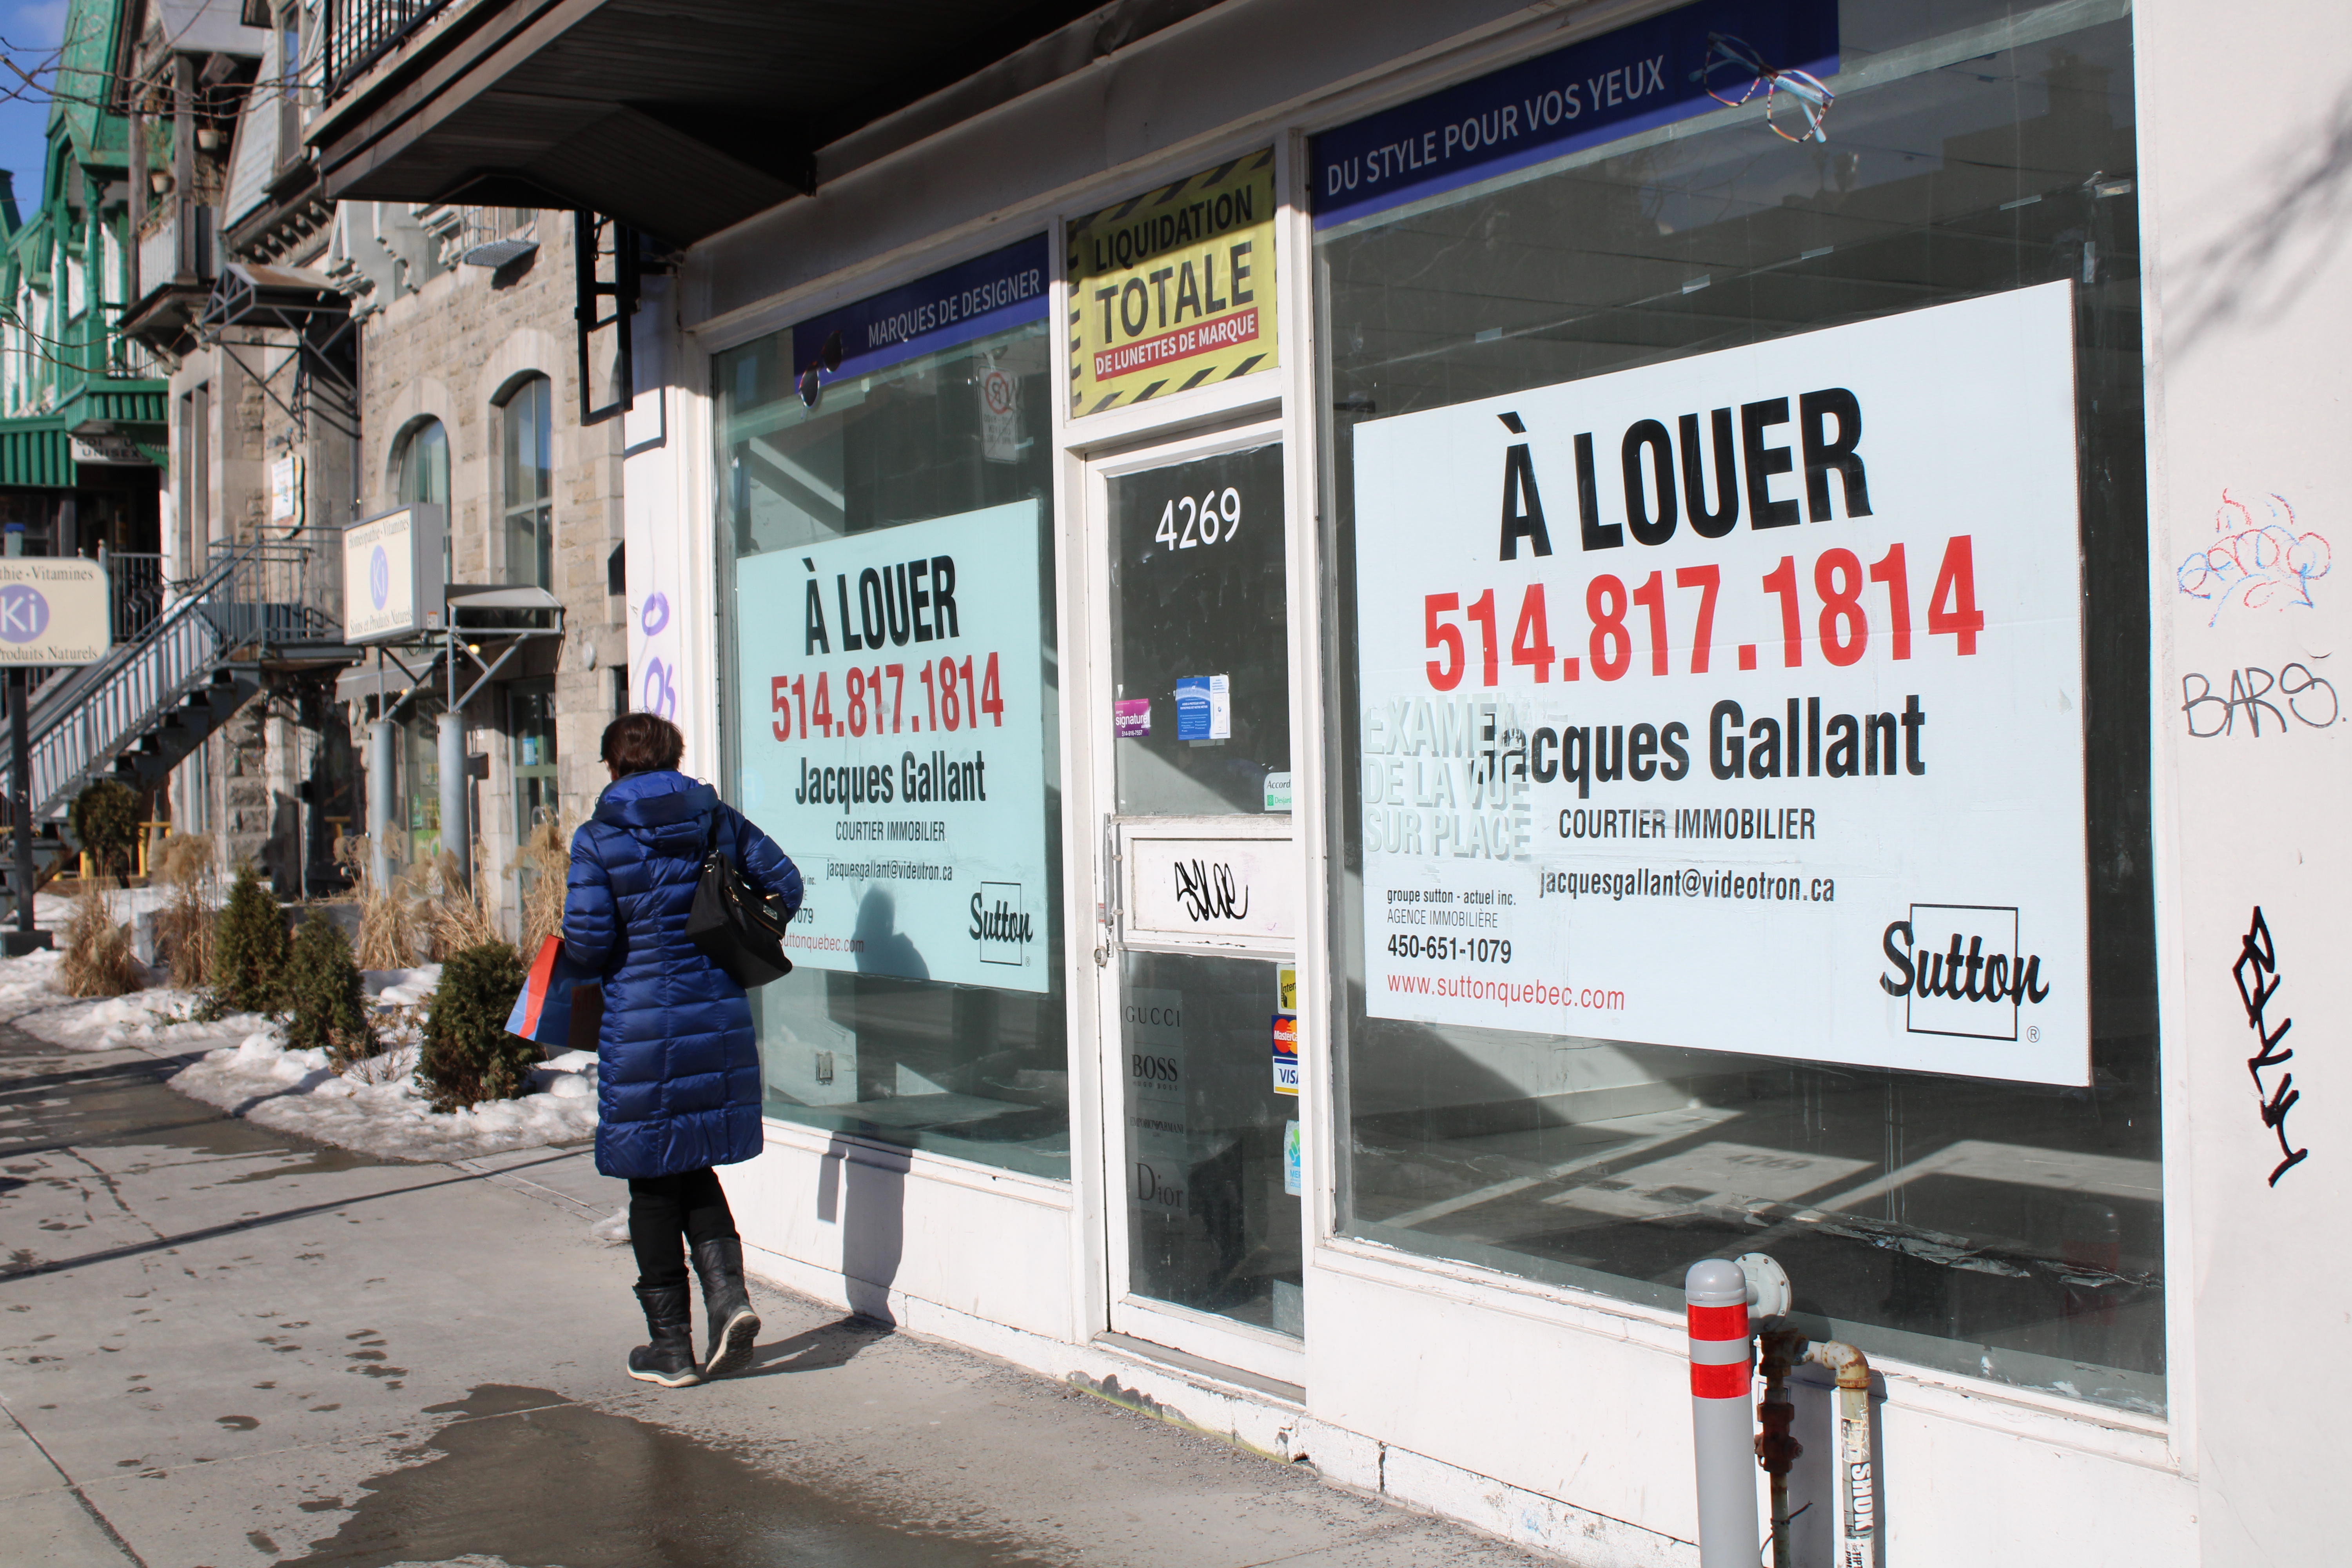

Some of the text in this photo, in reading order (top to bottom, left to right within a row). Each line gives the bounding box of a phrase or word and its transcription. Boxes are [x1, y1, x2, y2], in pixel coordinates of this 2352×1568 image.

[1327, 54, 1665, 197] DU STYLE POUR VOS YEUX
[1095, 184, 1252, 272] LIQUIDATION
[868, 269, 1040, 348] MARQUES DE DESIGNER
[1095, 241, 1254, 344] TOTALE
[1096, 314, 1255, 375] DE LUNETTES DE MARQUE
[1497, 387, 1873, 561] À LOUER
[348, 517, 409, 549] Homéopathie Vitamines
[1155, 487, 1241, 551] 4269
[31, 566, 94, 581] Vitamines
[372, 555, 385, 600] Ki
[0, 593, 37, 633] Ki
[350, 606, 412, 635] Soins et Produits Naturels
[802, 555, 960, 656] À LOUER
[1423, 534, 1984, 692] 514.817.1814
[47, 646, 98, 660] Naturels
[771, 652, 1004, 742] 514.817.1814
[1116, 713, 1147, 728] signature
[1364, 692, 1523, 753] EXAMEN
[1471, 695, 1926, 799] Jacques Gallant
[795, 750, 986, 815] Jacques Gallant
[1267, 779, 1290, 789] Accord
[1364, 755, 1524, 805] DE LA VUE
[836, 821, 946, 842] COURTIER IMMOBILIER
[1364, 807, 1525, 855] SUR PLACE
[1559, 808, 1815, 840] COURTIER IMMOBILIER
[807, 875, 816, 885] inc.
[826, 859, 953, 882] jacquesgallant@videotron.ca
[1539, 869, 1835, 903] jacquesgallant@videotron.ca
[969, 892, 1033, 944] Sutton
[1387, 889, 1420, 904] groupe
[1423, 889, 1453, 903] sutton
[1463, 890, 1494, 905] actuel
[1497, 891, 1516, 906] inc.
[1387, 909, 1498, 928] AGENCE IMMOBILIÈRE
[1387, 934, 1512, 964] 450-651-1079
[1879, 920, 2050, 1006] Sutton
[1281, 982, 1296, 994] Inter
[1387, 974, 1624, 1010] www.suttonquebec.com
[1125, 1006, 1180, 1027] GUCCI
[1131, 1054, 1178, 1082] BOSS
[1130, 1116, 1184, 1134] EMPORIO ARMANI
[1134, 1161, 1183, 1207] Dior
[1851, 1463, 1874, 1531] SHOK
